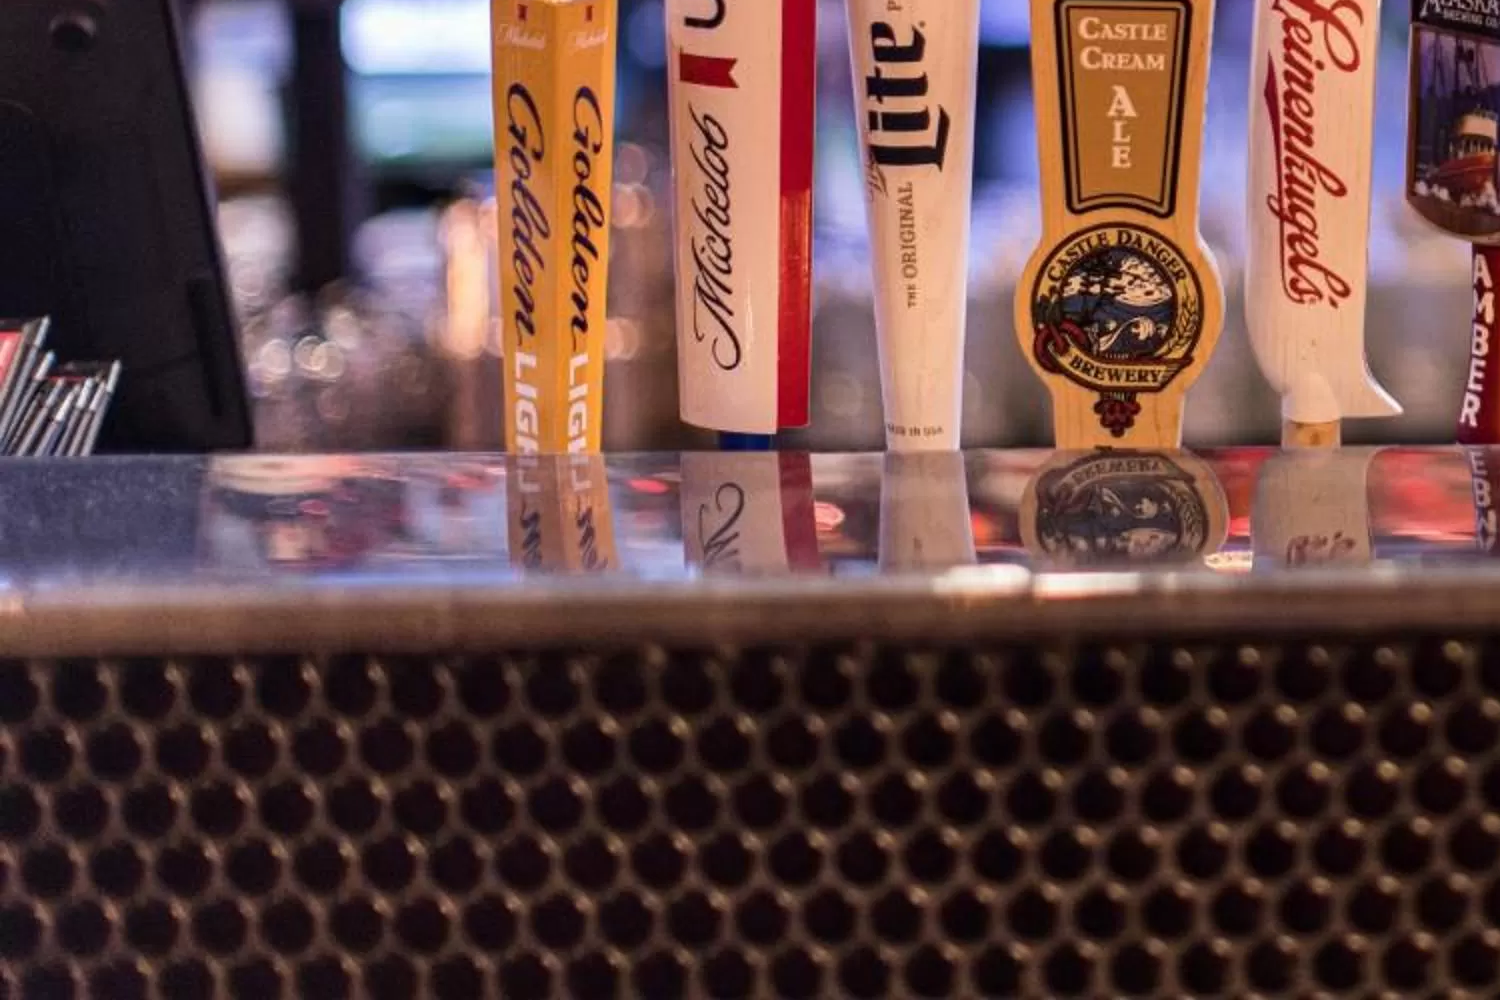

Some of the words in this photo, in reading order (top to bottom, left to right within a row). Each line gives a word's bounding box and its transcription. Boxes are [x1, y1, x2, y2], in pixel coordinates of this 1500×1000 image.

[1078, 16, 1168, 42] CASTLE
[1080, 46, 1166, 71] CREAM
[866, 21, 950, 172] Lite
[1107, 85, 1138, 169] ALE
[507, 83, 551, 346] Golden
[571, 86, 605, 352] Golden
[689, 102, 742, 371] Michelob
[897, 181, 919, 278] ORIGINAL
[1047, 231, 1107, 283] CASTLE
[1116, 229, 1187, 283] DANGER
[907, 283, 919, 310] THE
[1459, 254, 1495, 427] AMBER
[1069, 354, 1162, 384] BREWERY
